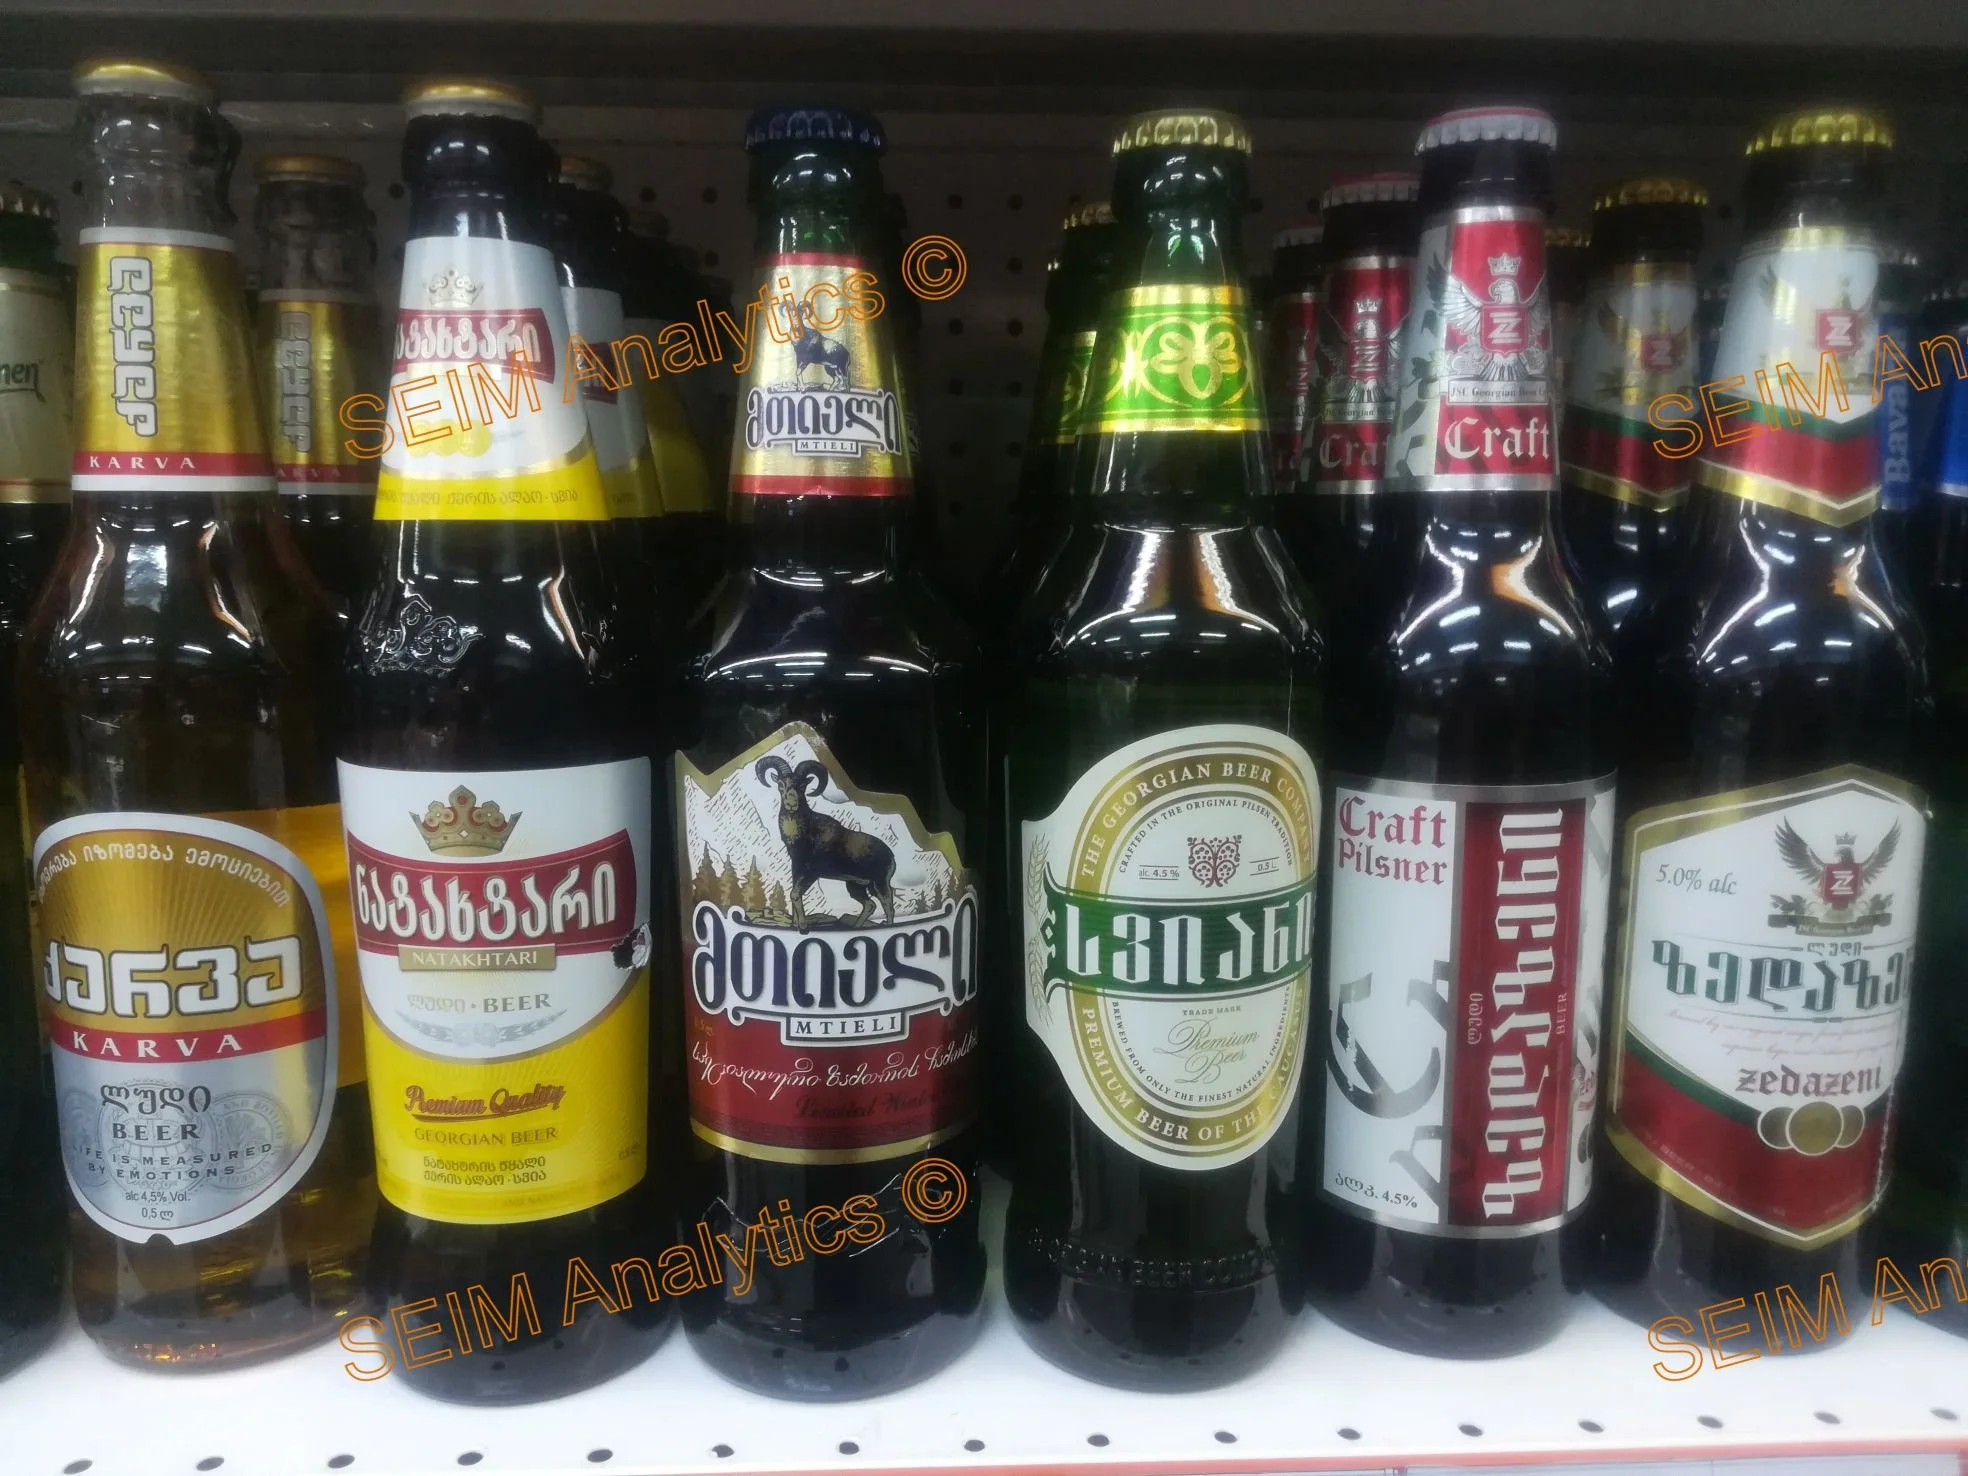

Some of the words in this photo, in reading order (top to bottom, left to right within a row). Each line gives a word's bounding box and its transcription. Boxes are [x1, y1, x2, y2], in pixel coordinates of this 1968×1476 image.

[395, 318, 541, 362] ატახტარი
[800, 441, 855, 450] MTIELI
[1444, 416, 1550, 459] Craft
[90, 456, 196, 470] KARVA
[1081, 835, 1106, 878] THE
[1102, 762, 1211, 829] GEORGIAN
[1221, 762, 1272, 784] BEER
[1338, 795, 1448, 848] Craft
[1118, 829, 1147, 874] CRAFTED
[1161, 806, 1183, 821] THE
[1186, 799, 1239, 811] ORIGINAL
[1338, 838, 1448, 886] Pilsner
[1656, 864, 1702, 893] 5.0%
[1708, 872, 1737, 895] alc
[412, 949, 537, 967] NATAKHTARI
[1651, 940, 1912, 1012] ზედაზე
[483, 991, 553, 1014] BEER
[1555, 992, 1568, 1036] BEER
[795, 1016, 896, 1034] MTIELI
[72, 1032, 242, 1059] KARVA
[1082, 1006, 1136, 1109] PREMIUM
[1136, 1107, 1189, 1141] BEER
[1198, 1124, 1225, 1141] OF
[1127, 1047, 1145, 1075] FROM
[1146, 1075, 1171, 1095] ONLY
[1174, 1090, 1195, 1102] THE
[1199, 1090, 1233, 1102] FINEST
[404, 1084, 487, 1115] Premium
[489, 1083, 566, 1114] Quality
[112, 1123, 200, 1141] BEER
[415, 1127, 504, 1145] GEORGIAN
[511, 1127, 557, 1145] BEER
[113, 1154, 130, 1164] IS
[143, 1143, 272, 1166] MEASURED
[88, 1162, 105, 1175] BY
[117, 1166, 235, 1180] EMOTIONS
[125, 1191, 138, 1201] alc
[1382, 1190, 1418, 1209] 4.5%
